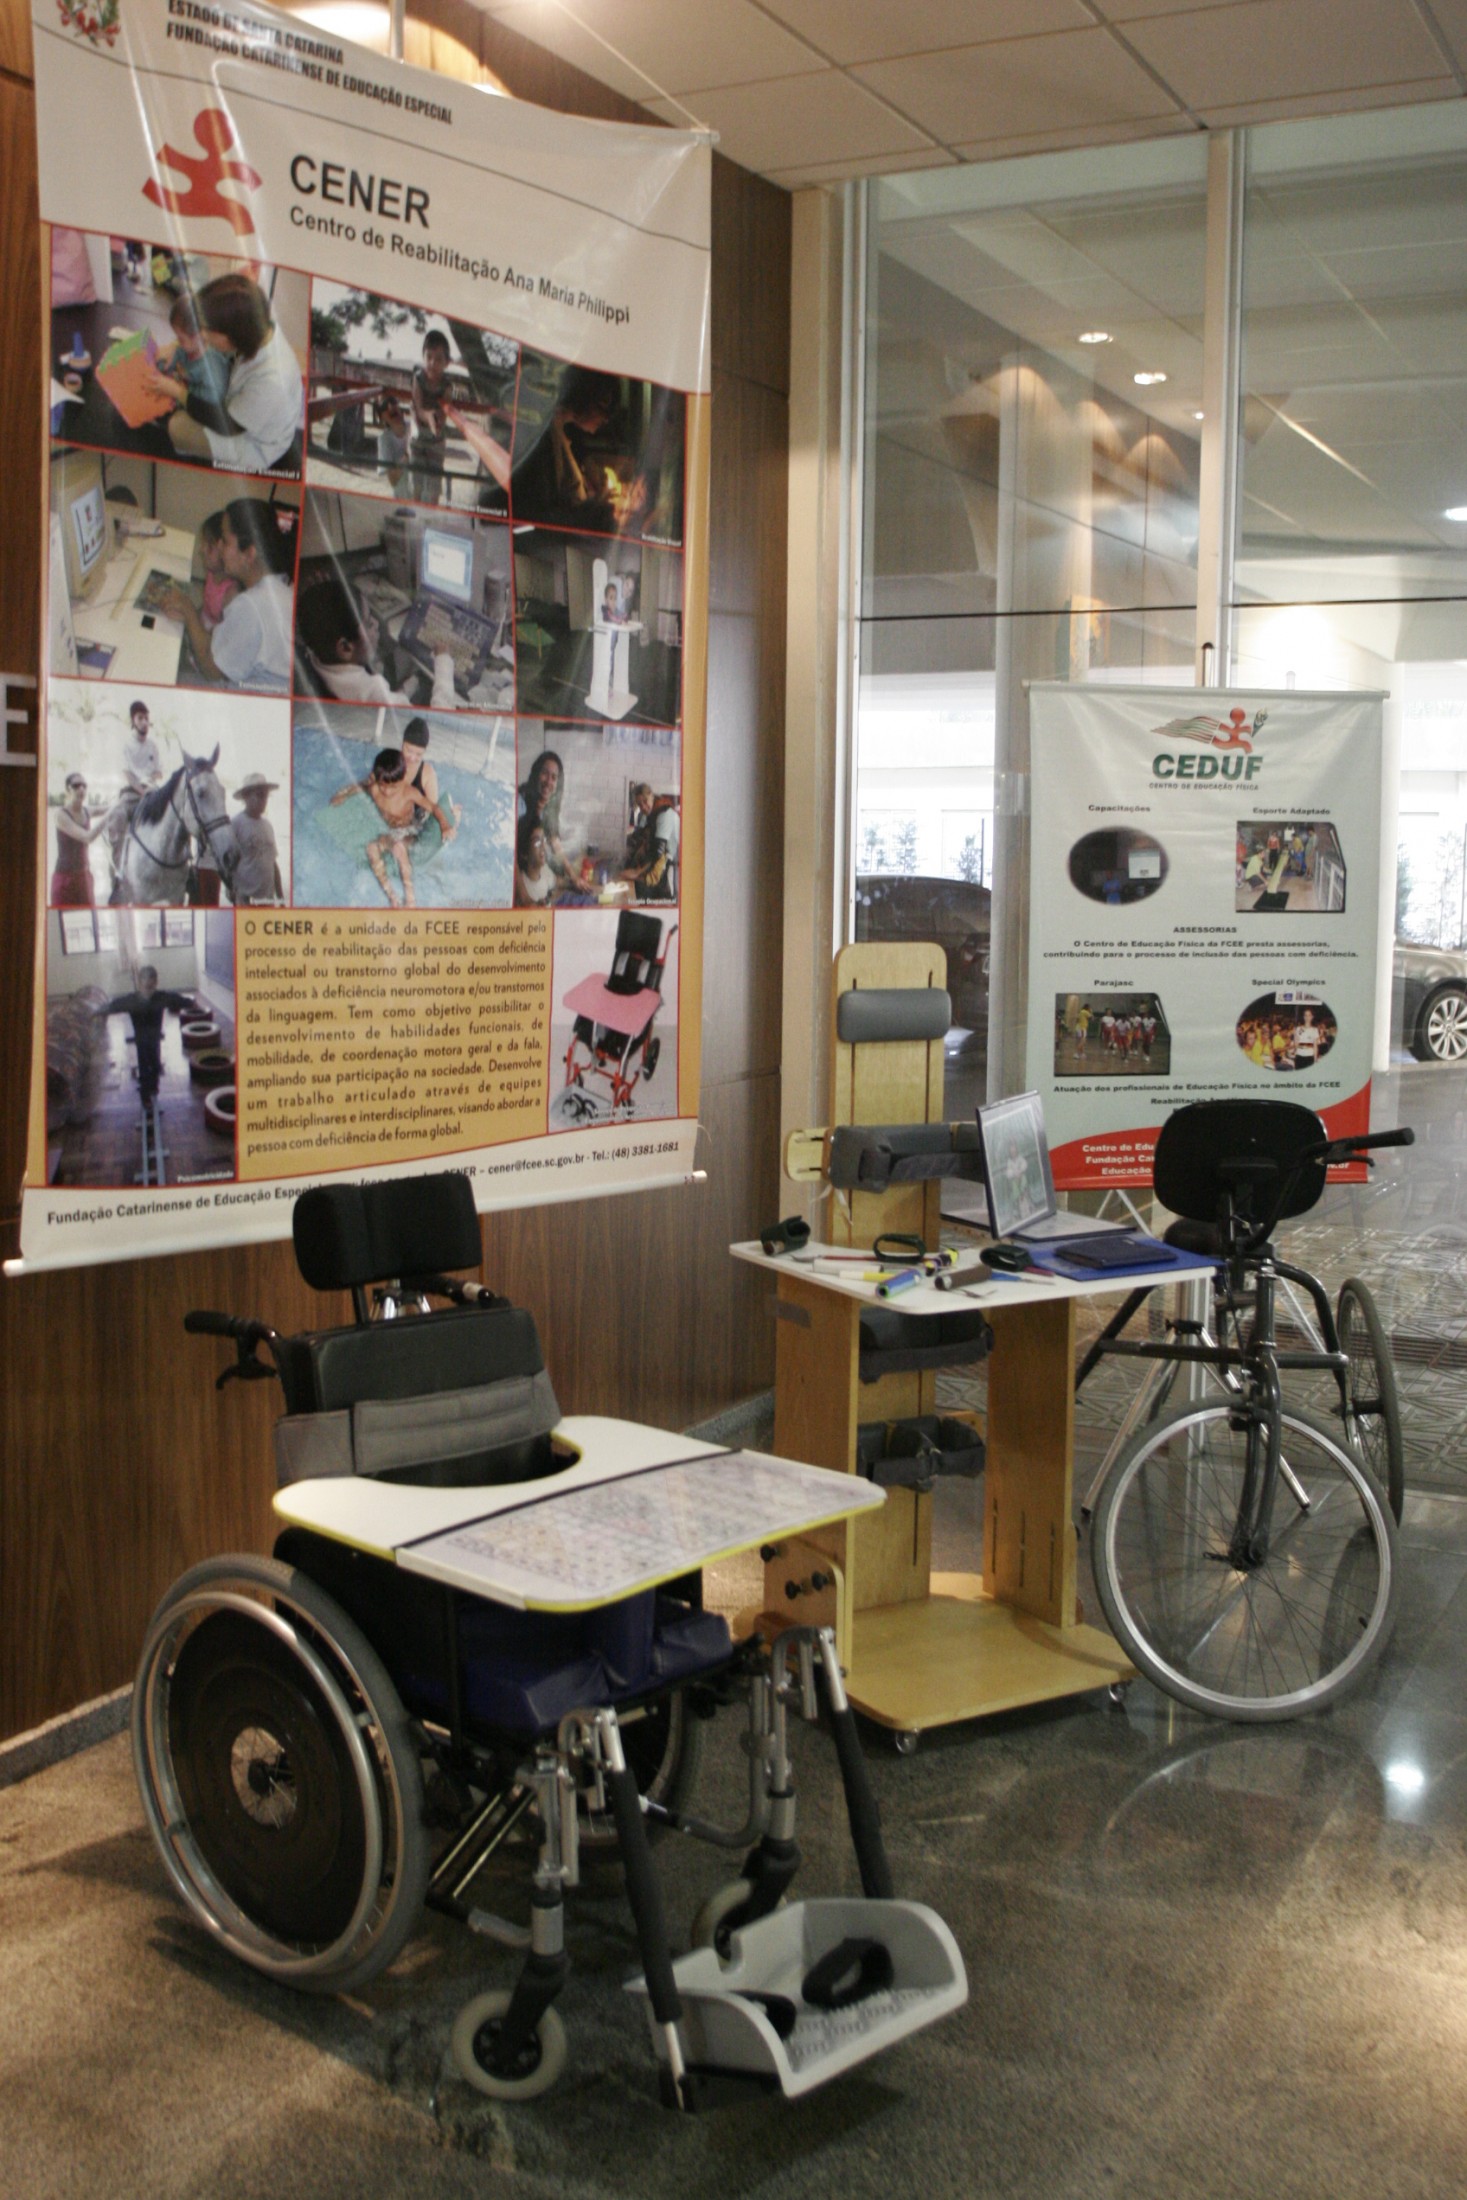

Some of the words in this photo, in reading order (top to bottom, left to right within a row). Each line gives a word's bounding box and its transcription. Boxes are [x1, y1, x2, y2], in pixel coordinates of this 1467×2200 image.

[285, 32, 344, 65] CATARINA
[166, 21, 239, 56] FUNDAÇÃO
[326, 68, 341, 87] DE
[343, 73, 403, 108] EDUCAÇÃO
[404, 93, 452, 125] ESPECIAL
[290, 154, 431, 229] CENER
[290, 206, 356, 241] Centro
[362, 226, 385, 249] de
[391, 234, 501, 281] Reabilitação
[503, 267, 534, 293] Ana
[539, 277, 575, 307] Maria
[577, 292, 630, 325] Philippi
[1152, 753, 1264, 781] CEDUF
[1149, 782, 1178, 790] CENTRO
[1193, 782, 1233, 791] EDUCAÇÃO
[1088, 804, 1151, 813] Capacitações
[1252, 807, 1288, 817] Esporte
[1290, 807, 1330, 817] Adaptado
[245, 920, 256, 935] O
[264, 920, 313, 935] CENER
[321, 923, 328, 935] é
[335, 926, 342, 935] a
[349, 921, 396, 935] unidade
[404, 921, 418, 935] da
[425, 921, 459, 935] FCEE
[467, 921, 523, 938] responsável
[528, 920, 546, 938] pelo
[245, 947, 296, 960] processo
[302, 942, 316, 956] de
[323, 941, 392, 959] reabilitação
[398, 942, 417, 955] das
[424, 945, 467, 957] pessoas
[473, 945, 494, 954] com
[499, 941, 545, 954] deficiência
[1131, 940, 1175, 948] Educação
[246, 964, 306, 979] intelectual
[313, 968, 328, 977] ou
[336, 966, 397, 977] transtorno
[405, 961, 440, 979] global
[446, 961, 461, 975] do
[468, 960, 545, 975] desenvolvimento
[246, 986, 307, 1001] associados
[312, 986, 318, 999] à
[323, 984, 386, 998] deficiência
[391, 986, 465, 997] neuromotora
[469, 982, 491, 998] e/ou
[494, 982, 544, 993] transtornos
[1094, 979, 1134, 987] Parajasc
[1252, 979, 1284, 987] Special
[1286, 979, 1326, 987] Olympics
[246, 1009, 260, 1023] da
[348, 1005, 372, 1019] Tem
[382, 1006, 416, 1018] como
[425, 1002, 471, 1020] objetivo
[479, 999, 531, 1017] possibilitar
[538, 1002, 544, 1011] o
[247, 1028, 355, 1045] desenvolvimento
[366, 1026, 380, 1039] de
[391, 1024, 460, 1038] habilidades
[532, 1017, 543, 1030] de
[320, 1048, 335, 1062] de
[342, 1046, 418, 1062] coordenação
[424, 1045, 462, 1057] motora
[468, 1040, 492, 1058] geral
[497, 1043, 502, 1052] e
[507, 1038, 518, 1051] da
[247, 1070, 306, 1090] ampliando
[312, 1074, 331, 1083] sua
[336, 1067, 409, 1085] participação
[414, 1066, 426, 1078] na
[489, 1056, 542, 1072] Desenvolve
[247, 1100, 267, 1110] um
[278, 1091, 334, 1108] trabalho
[344, 1085, 416, 1103] articulado
[426, 1083, 469, 1097] através
[478, 1080, 491, 1093] de
[499, 1078, 541, 1093] equipes
[1113, 1084, 1170, 1092] profissionais
[1186, 1082, 1229, 1090] Educação
[247, 1112, 346, 1132] multidisciplinares
[349, 1114, 357, 1123] e
[458, 1098, 495, 1114] visando
[497, 1096, 532, 1109] abordar
[535, 1098, 540, 1106] a
[247, 1140, 287, 1157] pessoa
[289, 1138, 313, 1149] com
[315, 1130, 376, 1147] deficiência
[378, 1128, 392, 1142] de
[394, 1126, 428, 1140] forma
[1082, 1144, 1117, 1153] Centro
[1119, 1143, 1132, 1151] de
[488, 1154, 584, 1175] cener@fcee.sc.gov.br
[611, 1147, 630, 1162] (48)
[631, 1141, 679, 1157] 3381-1681
[1085, 1155, 1136, 1164] Fundação
[1101, 1166, 1152, 1175] Educação
[47, 1206, 113, 1225] Fundação
[116, 1199, 192, 1218] Catarinense
[196, 1195, 211, 1209] de
[213, 1190, 271, 1207] Educação
